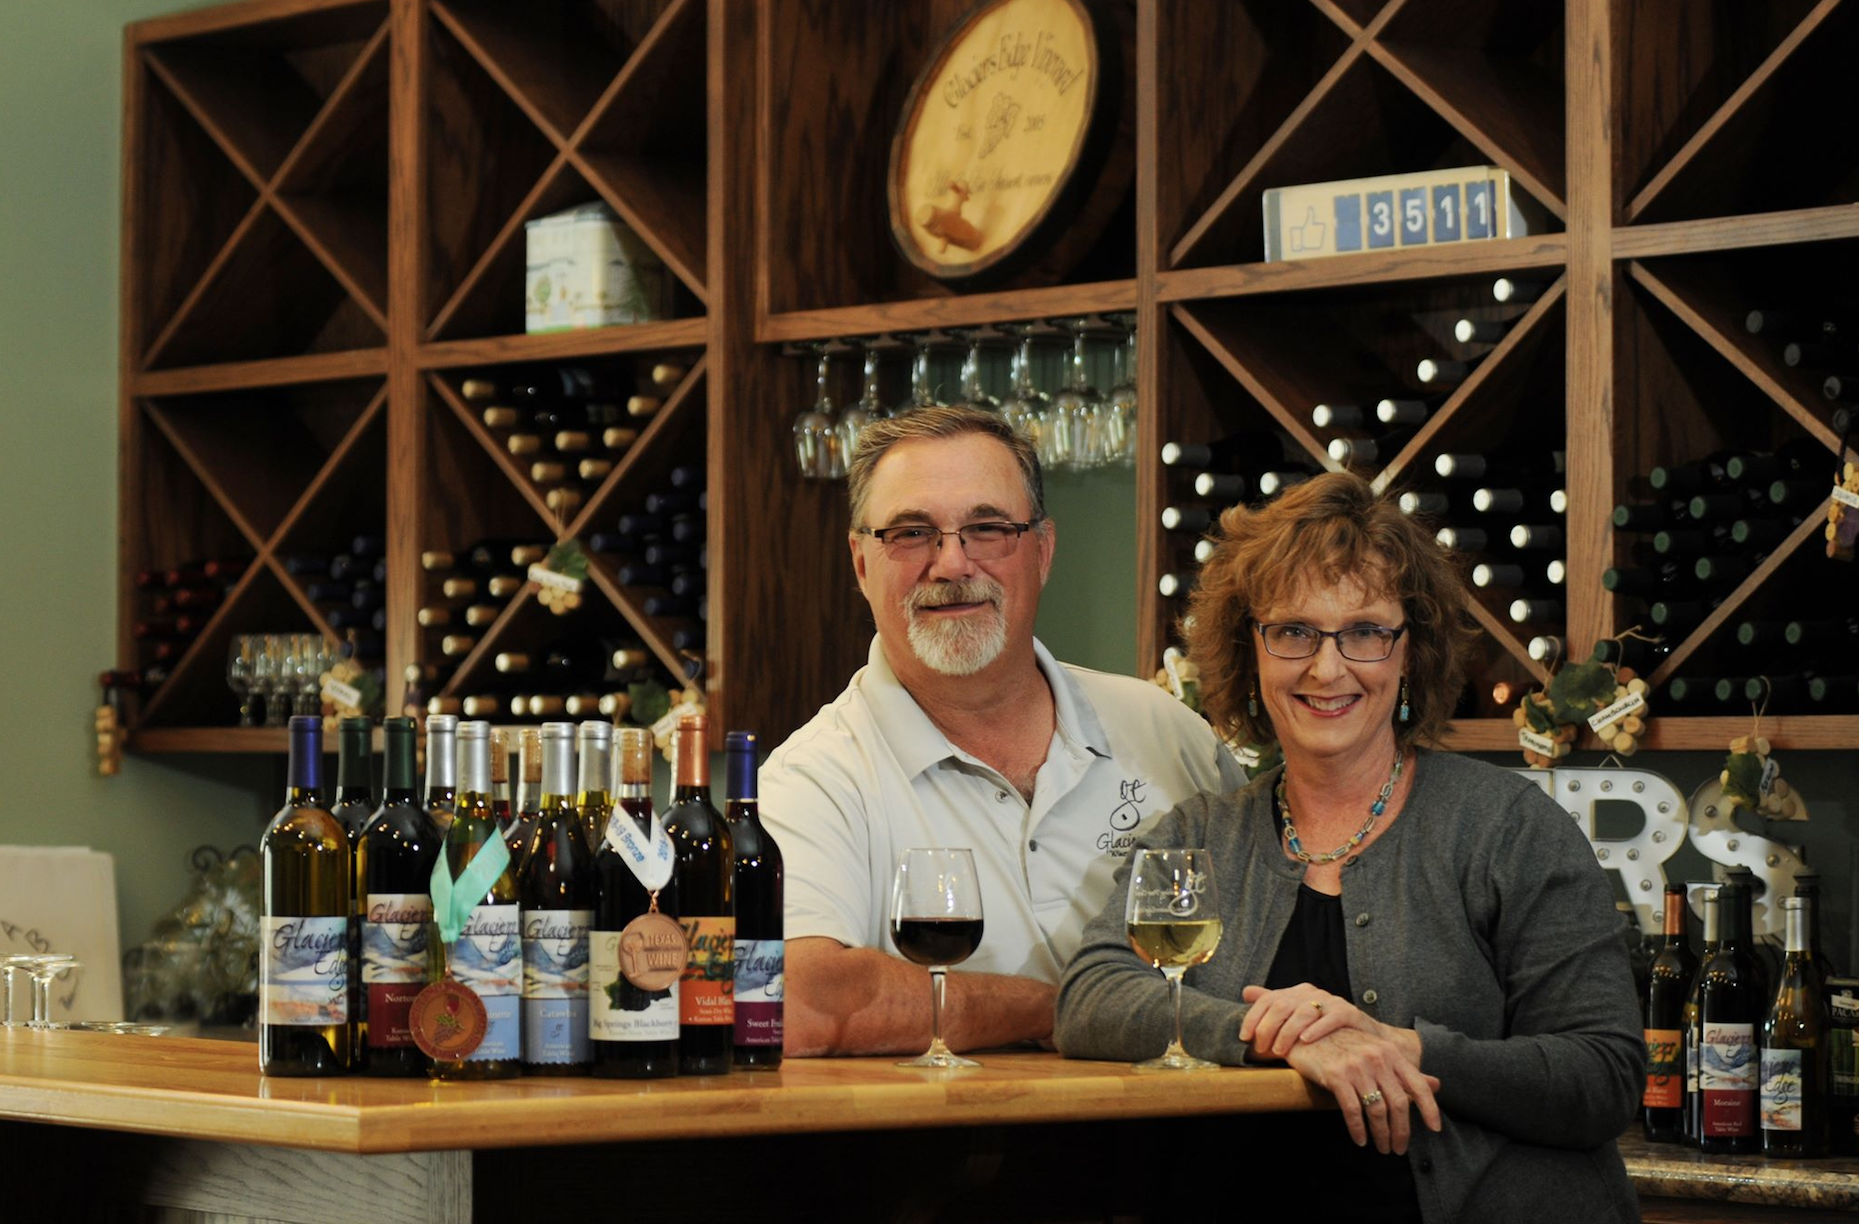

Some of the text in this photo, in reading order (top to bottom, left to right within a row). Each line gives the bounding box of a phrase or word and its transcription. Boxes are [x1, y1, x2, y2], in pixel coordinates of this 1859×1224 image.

[648, 934, 676, 945] TEXAS
[646, 952, 678, 966] WINE
[695, 996, 716, 1006] Vidal
[539, 1007, 577, 1019] Catawba
[604, 1019, 632, 1030] Springs
[746, 1018, 769, 1028] Sweet
